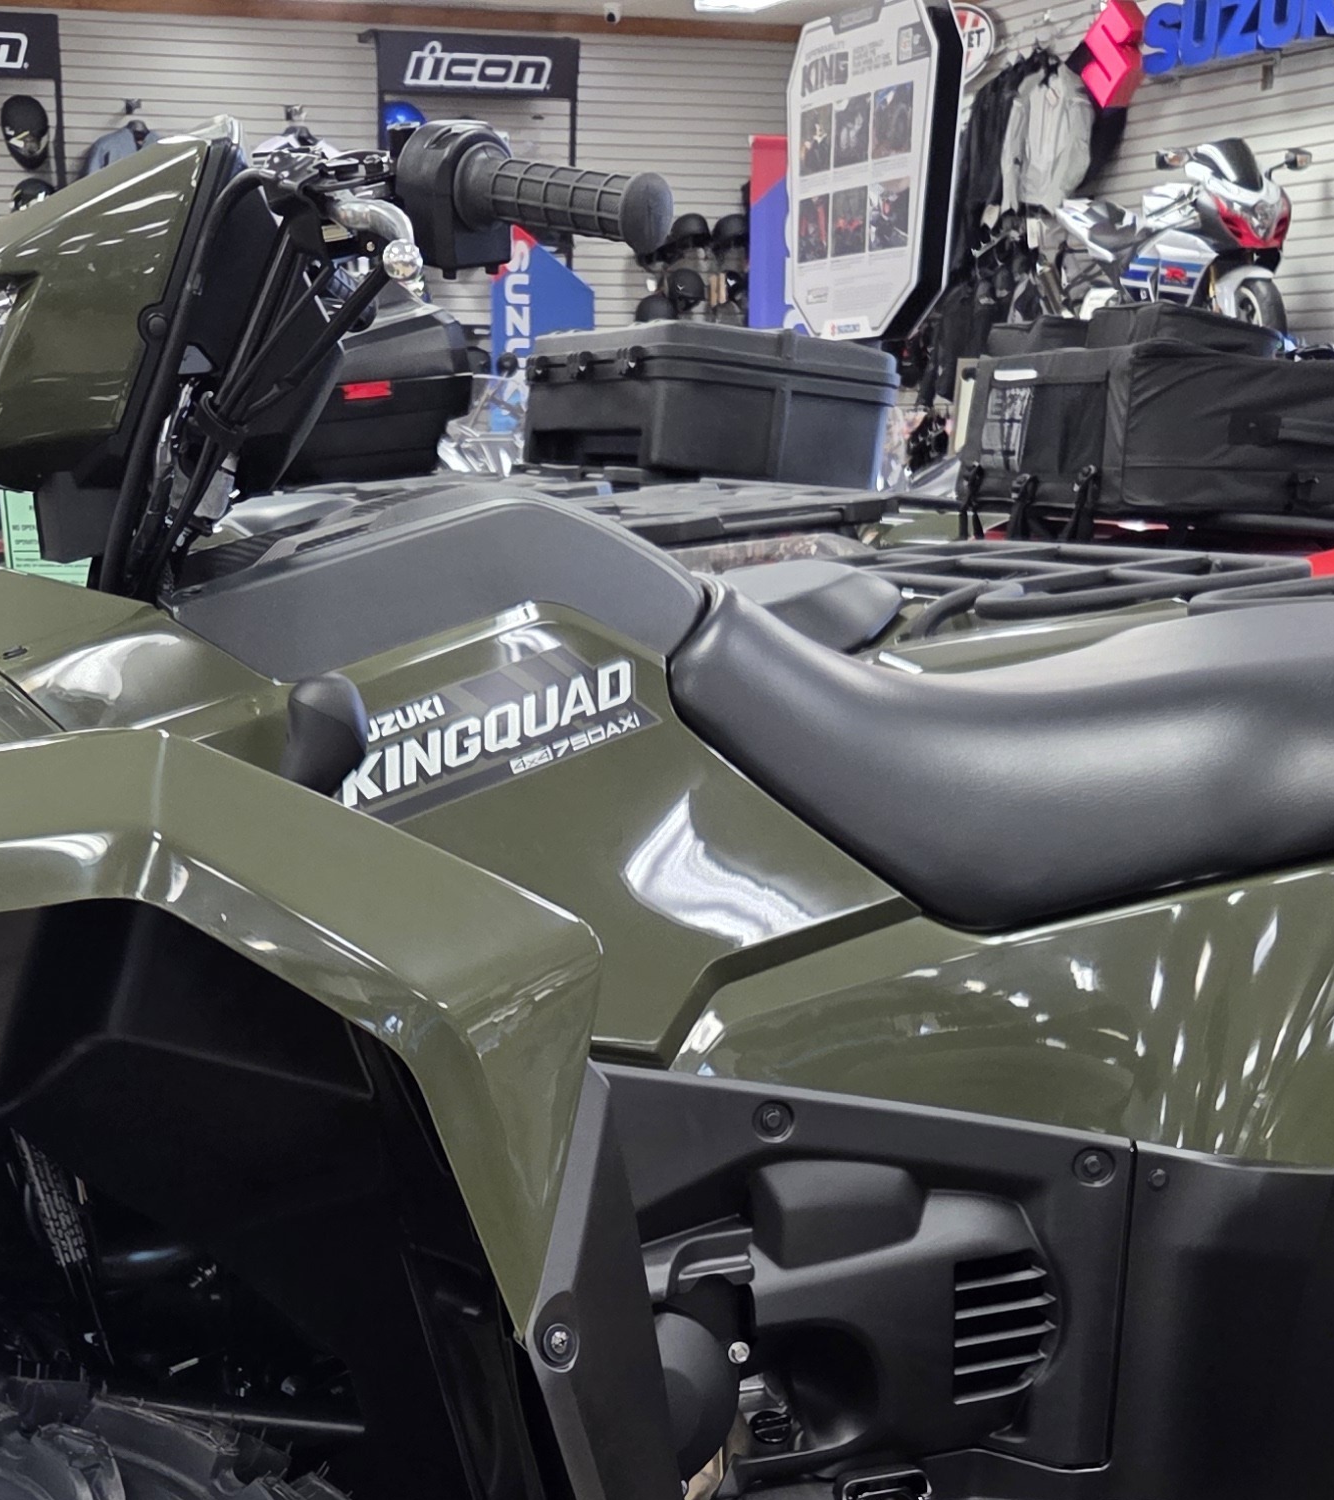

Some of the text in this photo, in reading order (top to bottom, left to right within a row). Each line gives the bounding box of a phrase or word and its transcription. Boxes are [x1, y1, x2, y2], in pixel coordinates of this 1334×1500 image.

[962, 28, 986, 48] ET
[800, 51, 849, 97] KING
[342, 659, 633, 808] KINGQUAD
[367, 695, 446, 742] UZUKI
